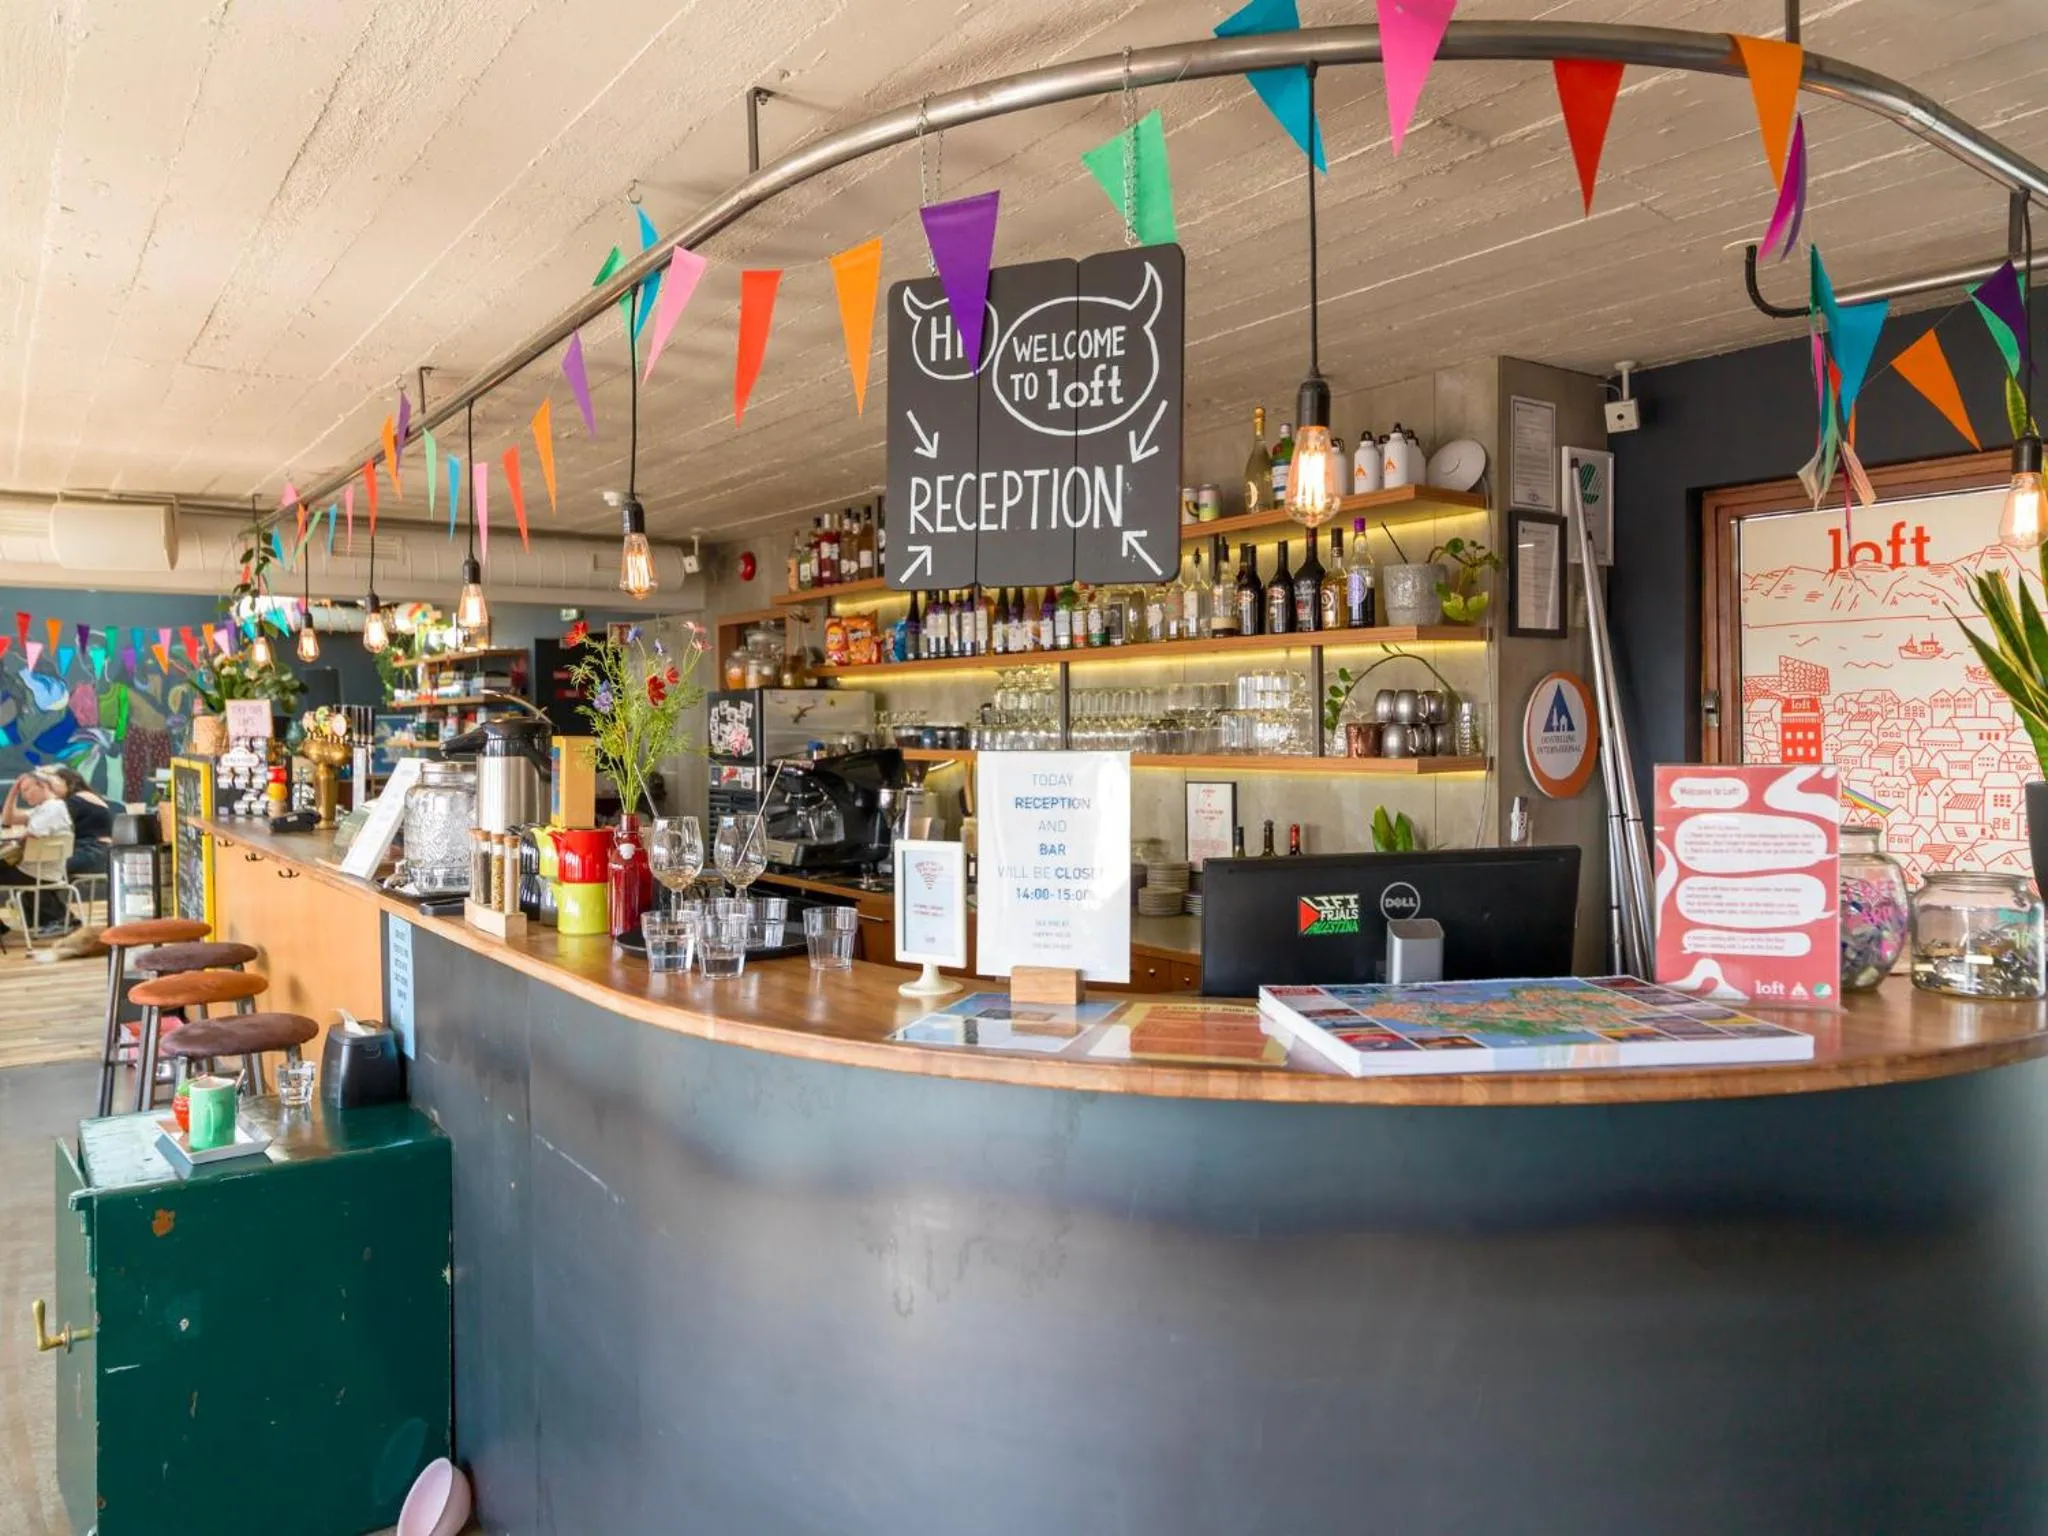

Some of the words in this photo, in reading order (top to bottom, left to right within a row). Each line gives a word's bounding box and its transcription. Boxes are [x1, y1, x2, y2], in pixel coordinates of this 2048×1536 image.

[1012, 325, 1126, 363] WELCOME
[1010, 372, 1039, 402] TO
[1046, 363, 1124, 411] loft
[909, 464, 1124, 534] RECEPTION
[1827, 520, 1931, 573] loft
[1031, 773, 1074, 787] TODAY
[1014, 796, 1092, 810] RECEPTION
[1038, 819, 1068, 833] AND
[1038, 843, 1067, 856] BAR
[997, 865, 1028, 879] WILL
[1033, 866, 1051, 879] BE
[1055, 866, 1104, 880] CLOS
[1385, 896, 1417, 909] DELL
[1755, 979, 1785, 995] loft
